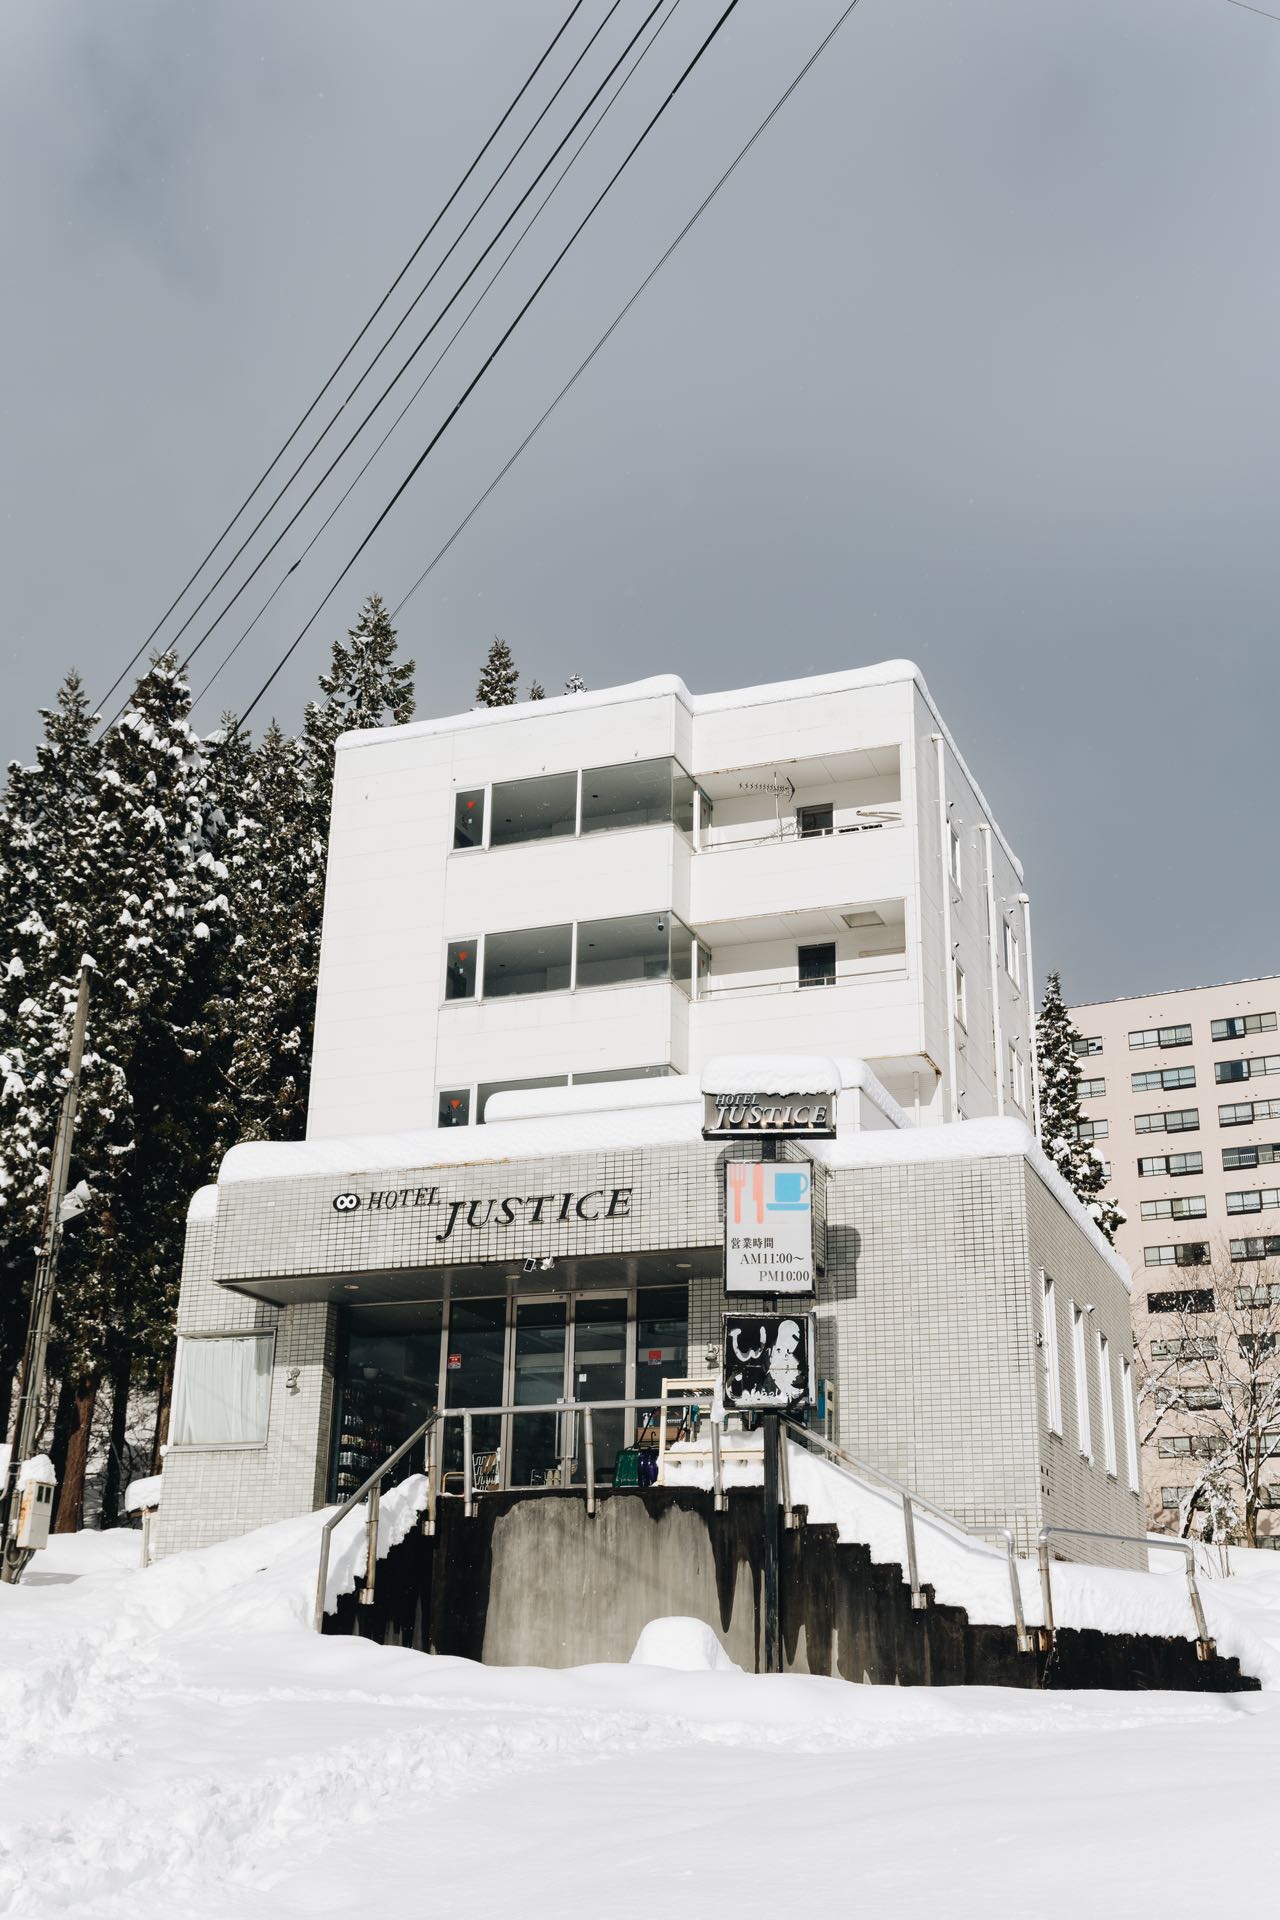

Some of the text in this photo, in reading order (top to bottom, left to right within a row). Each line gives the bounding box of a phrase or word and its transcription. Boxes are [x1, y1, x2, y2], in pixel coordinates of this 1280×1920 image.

[715, 1094, 760, 1105] HOTEL
[710, 1106, 828, 1129] JUSTICE
[367, 1186, 633, 1242] HOTEL JUSTICE
[731, 1237, 775, 1249] 営業時間
[759, 1270, 810, 1282] PM10:00
